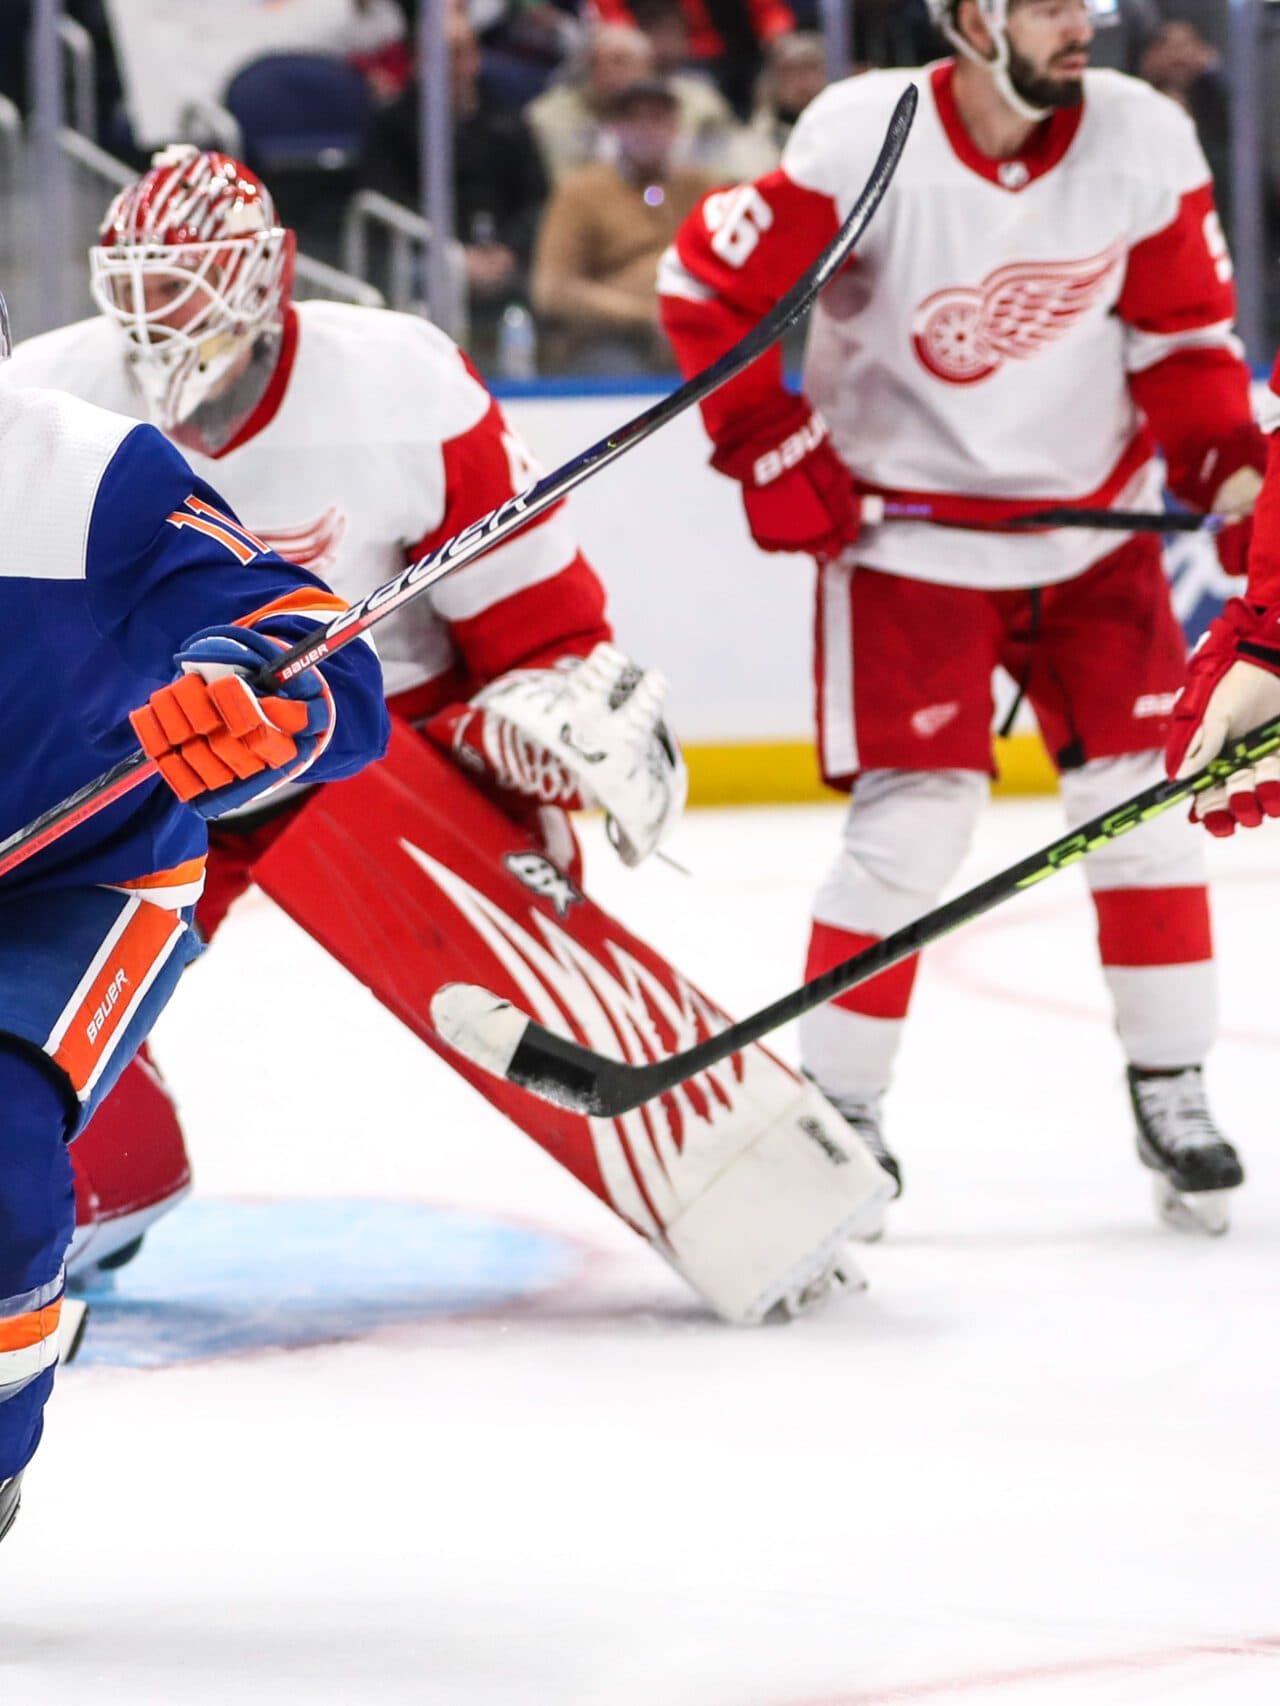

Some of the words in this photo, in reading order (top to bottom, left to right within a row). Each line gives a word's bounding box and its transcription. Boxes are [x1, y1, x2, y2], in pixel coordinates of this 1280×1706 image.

[702, 183, 774, 269] 96
[165, 494, 272, 567] 11
[86, 968, 130, 1046] BAUER
